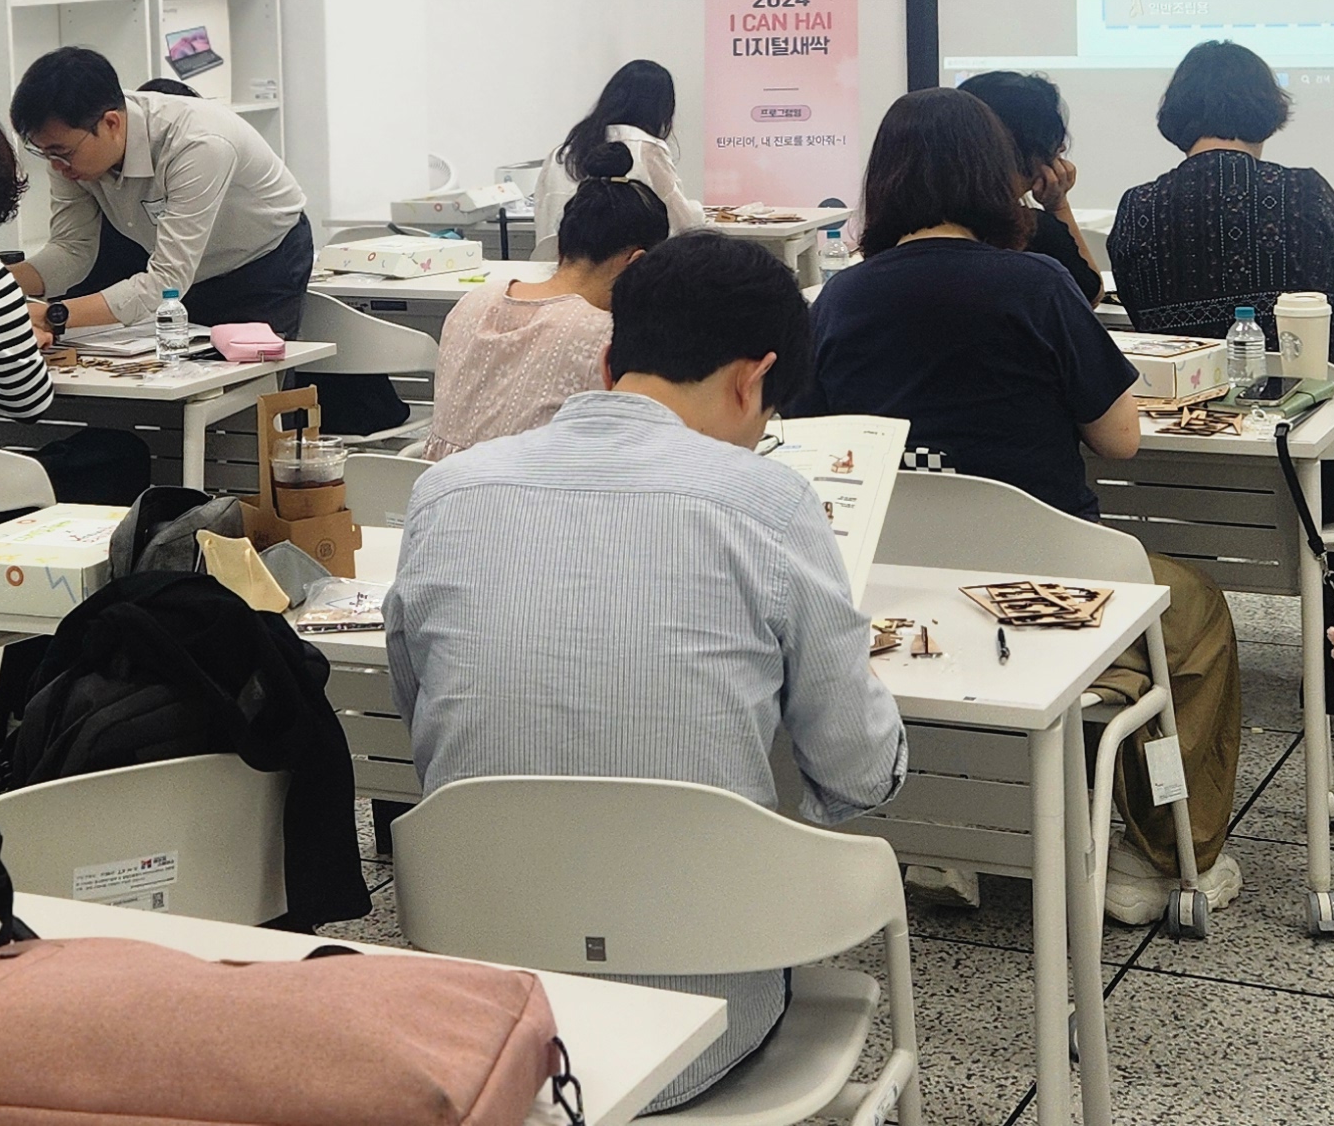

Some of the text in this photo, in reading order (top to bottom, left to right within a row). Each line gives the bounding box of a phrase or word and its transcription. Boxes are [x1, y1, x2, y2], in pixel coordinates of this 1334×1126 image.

[730, 11, 832, 32] I CAN HAI
[732, 35, 830, 56] 디지털새싹
[761, 136, 771, 147] 내
[774, 135, 803, 147] 진로를
